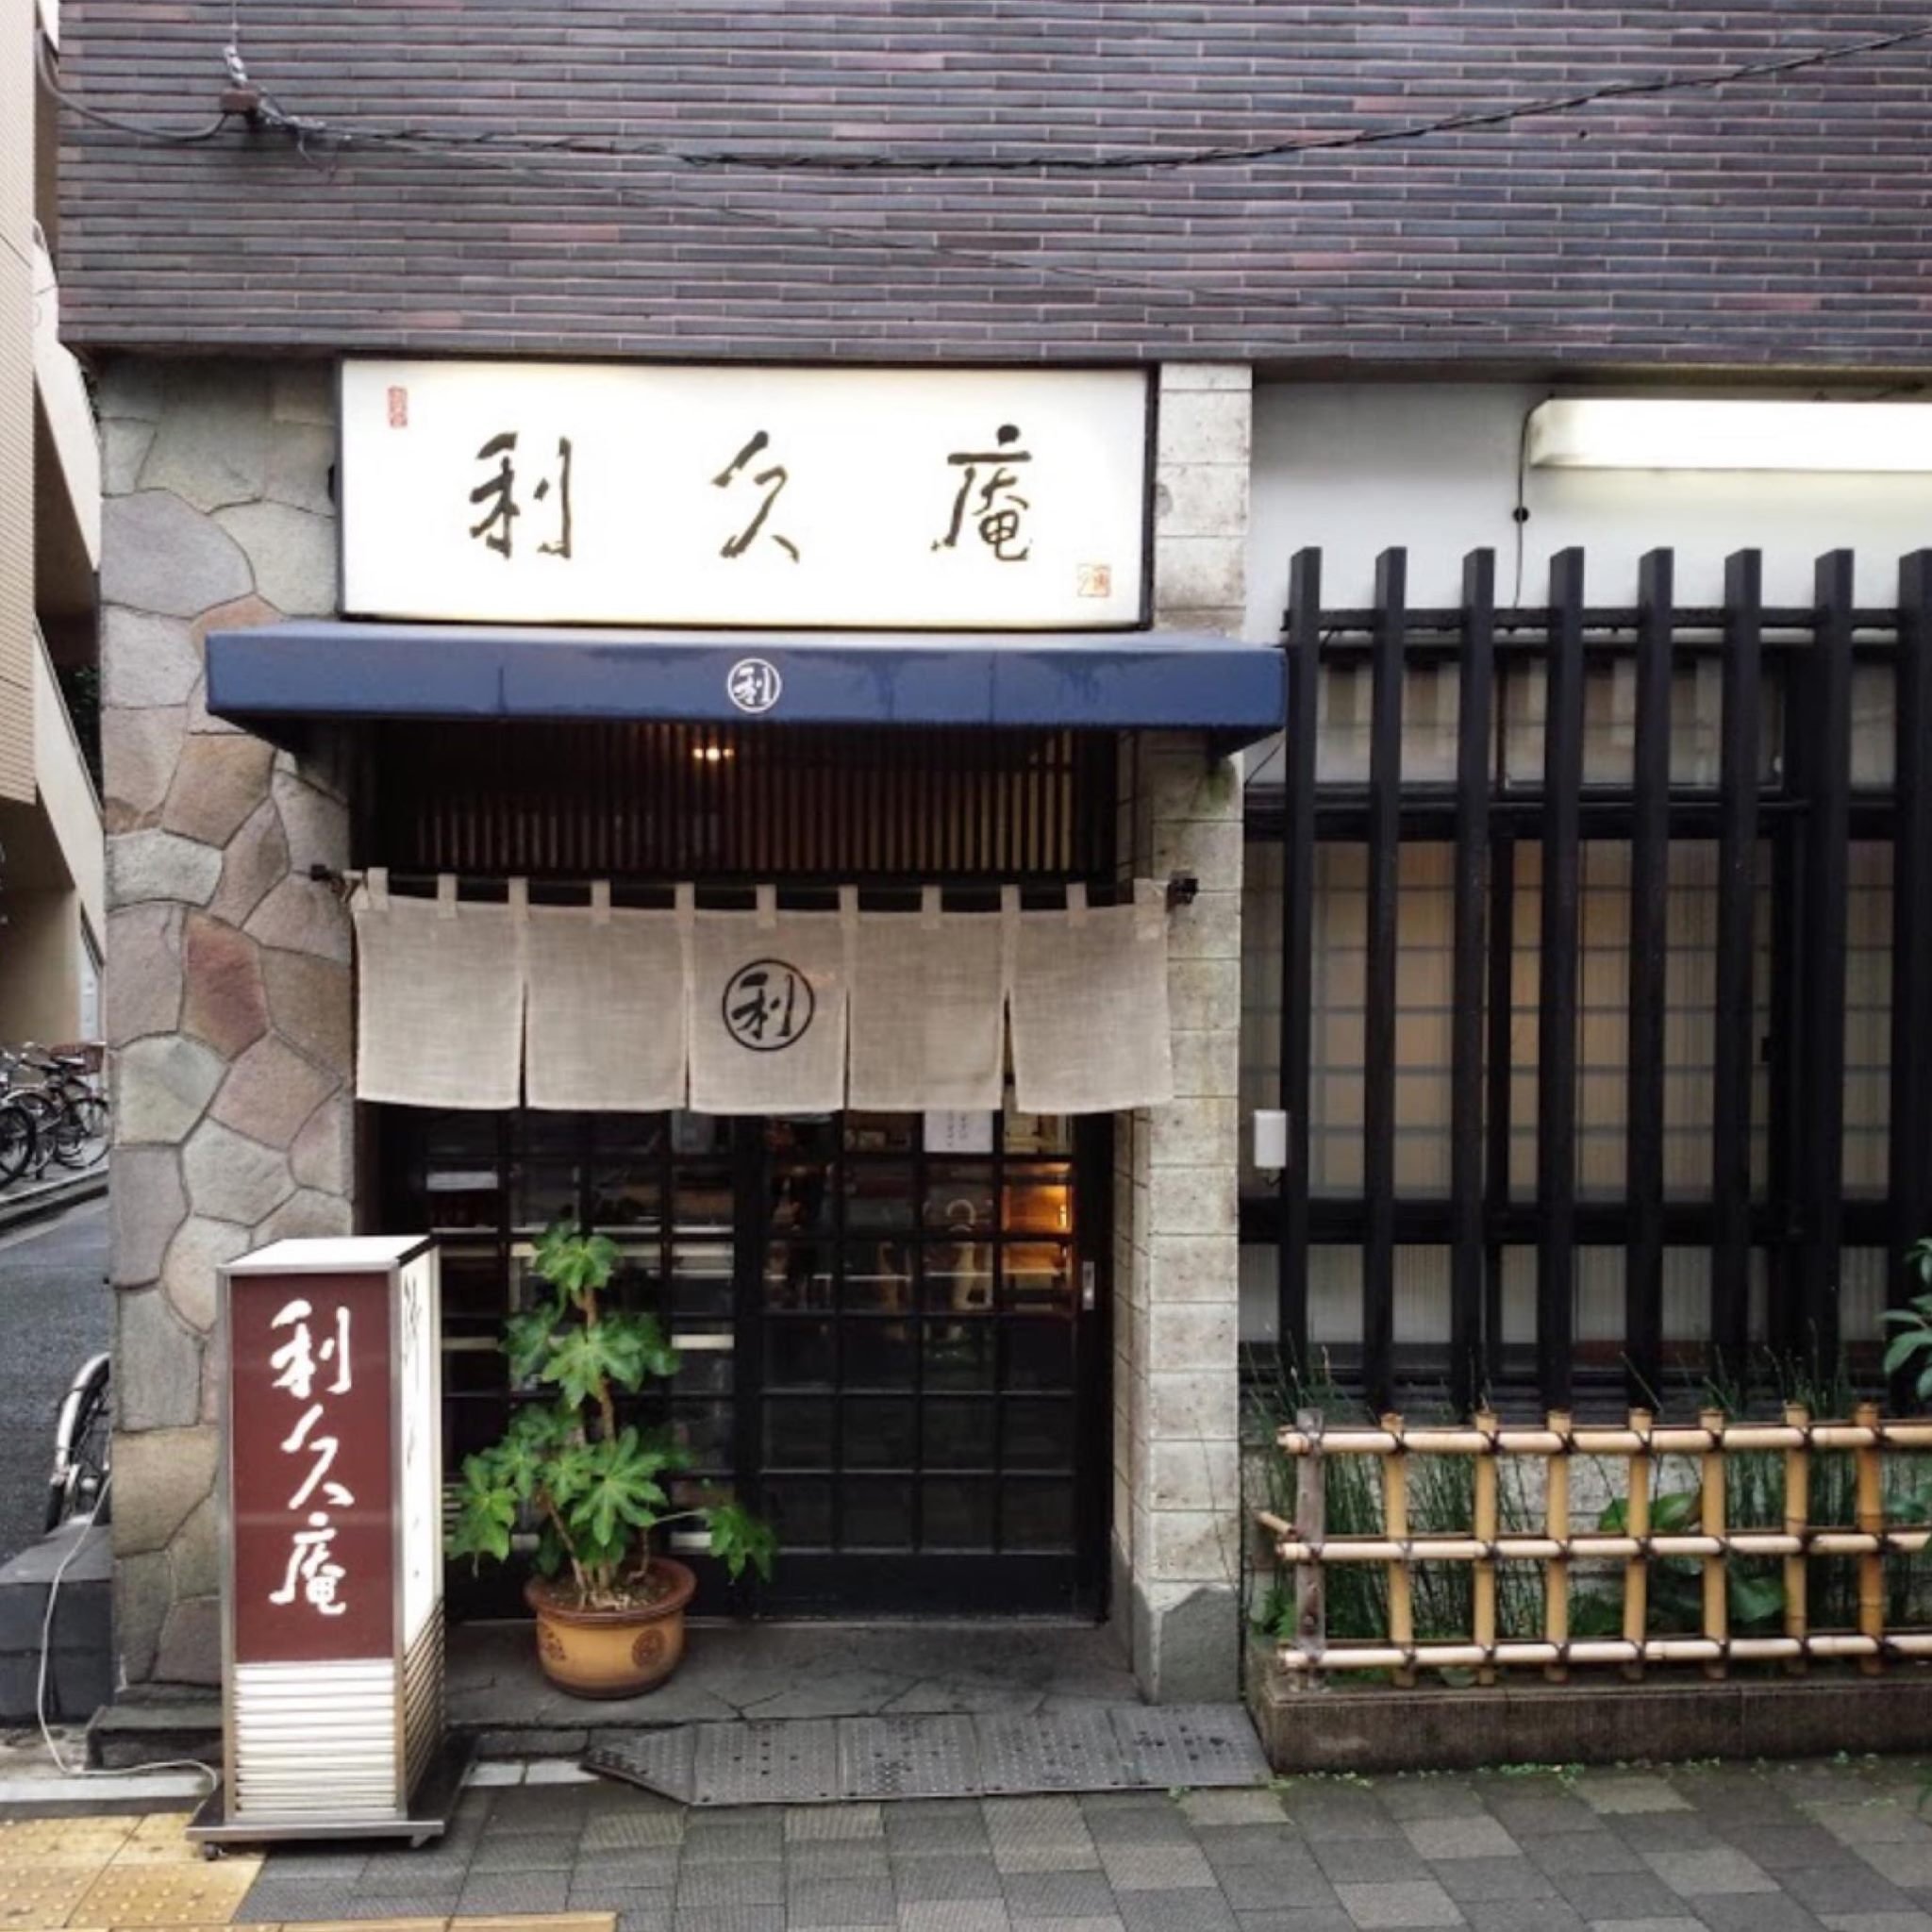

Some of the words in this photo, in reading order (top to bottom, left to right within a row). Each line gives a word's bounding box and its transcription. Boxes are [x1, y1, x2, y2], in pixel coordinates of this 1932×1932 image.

[467, 423, 1034, 563] 利久庵
[731, 663, 774, 708] 利
[729, 970, 796, 1042] 利
[269, 1298, 355, 1616] 利久庵
